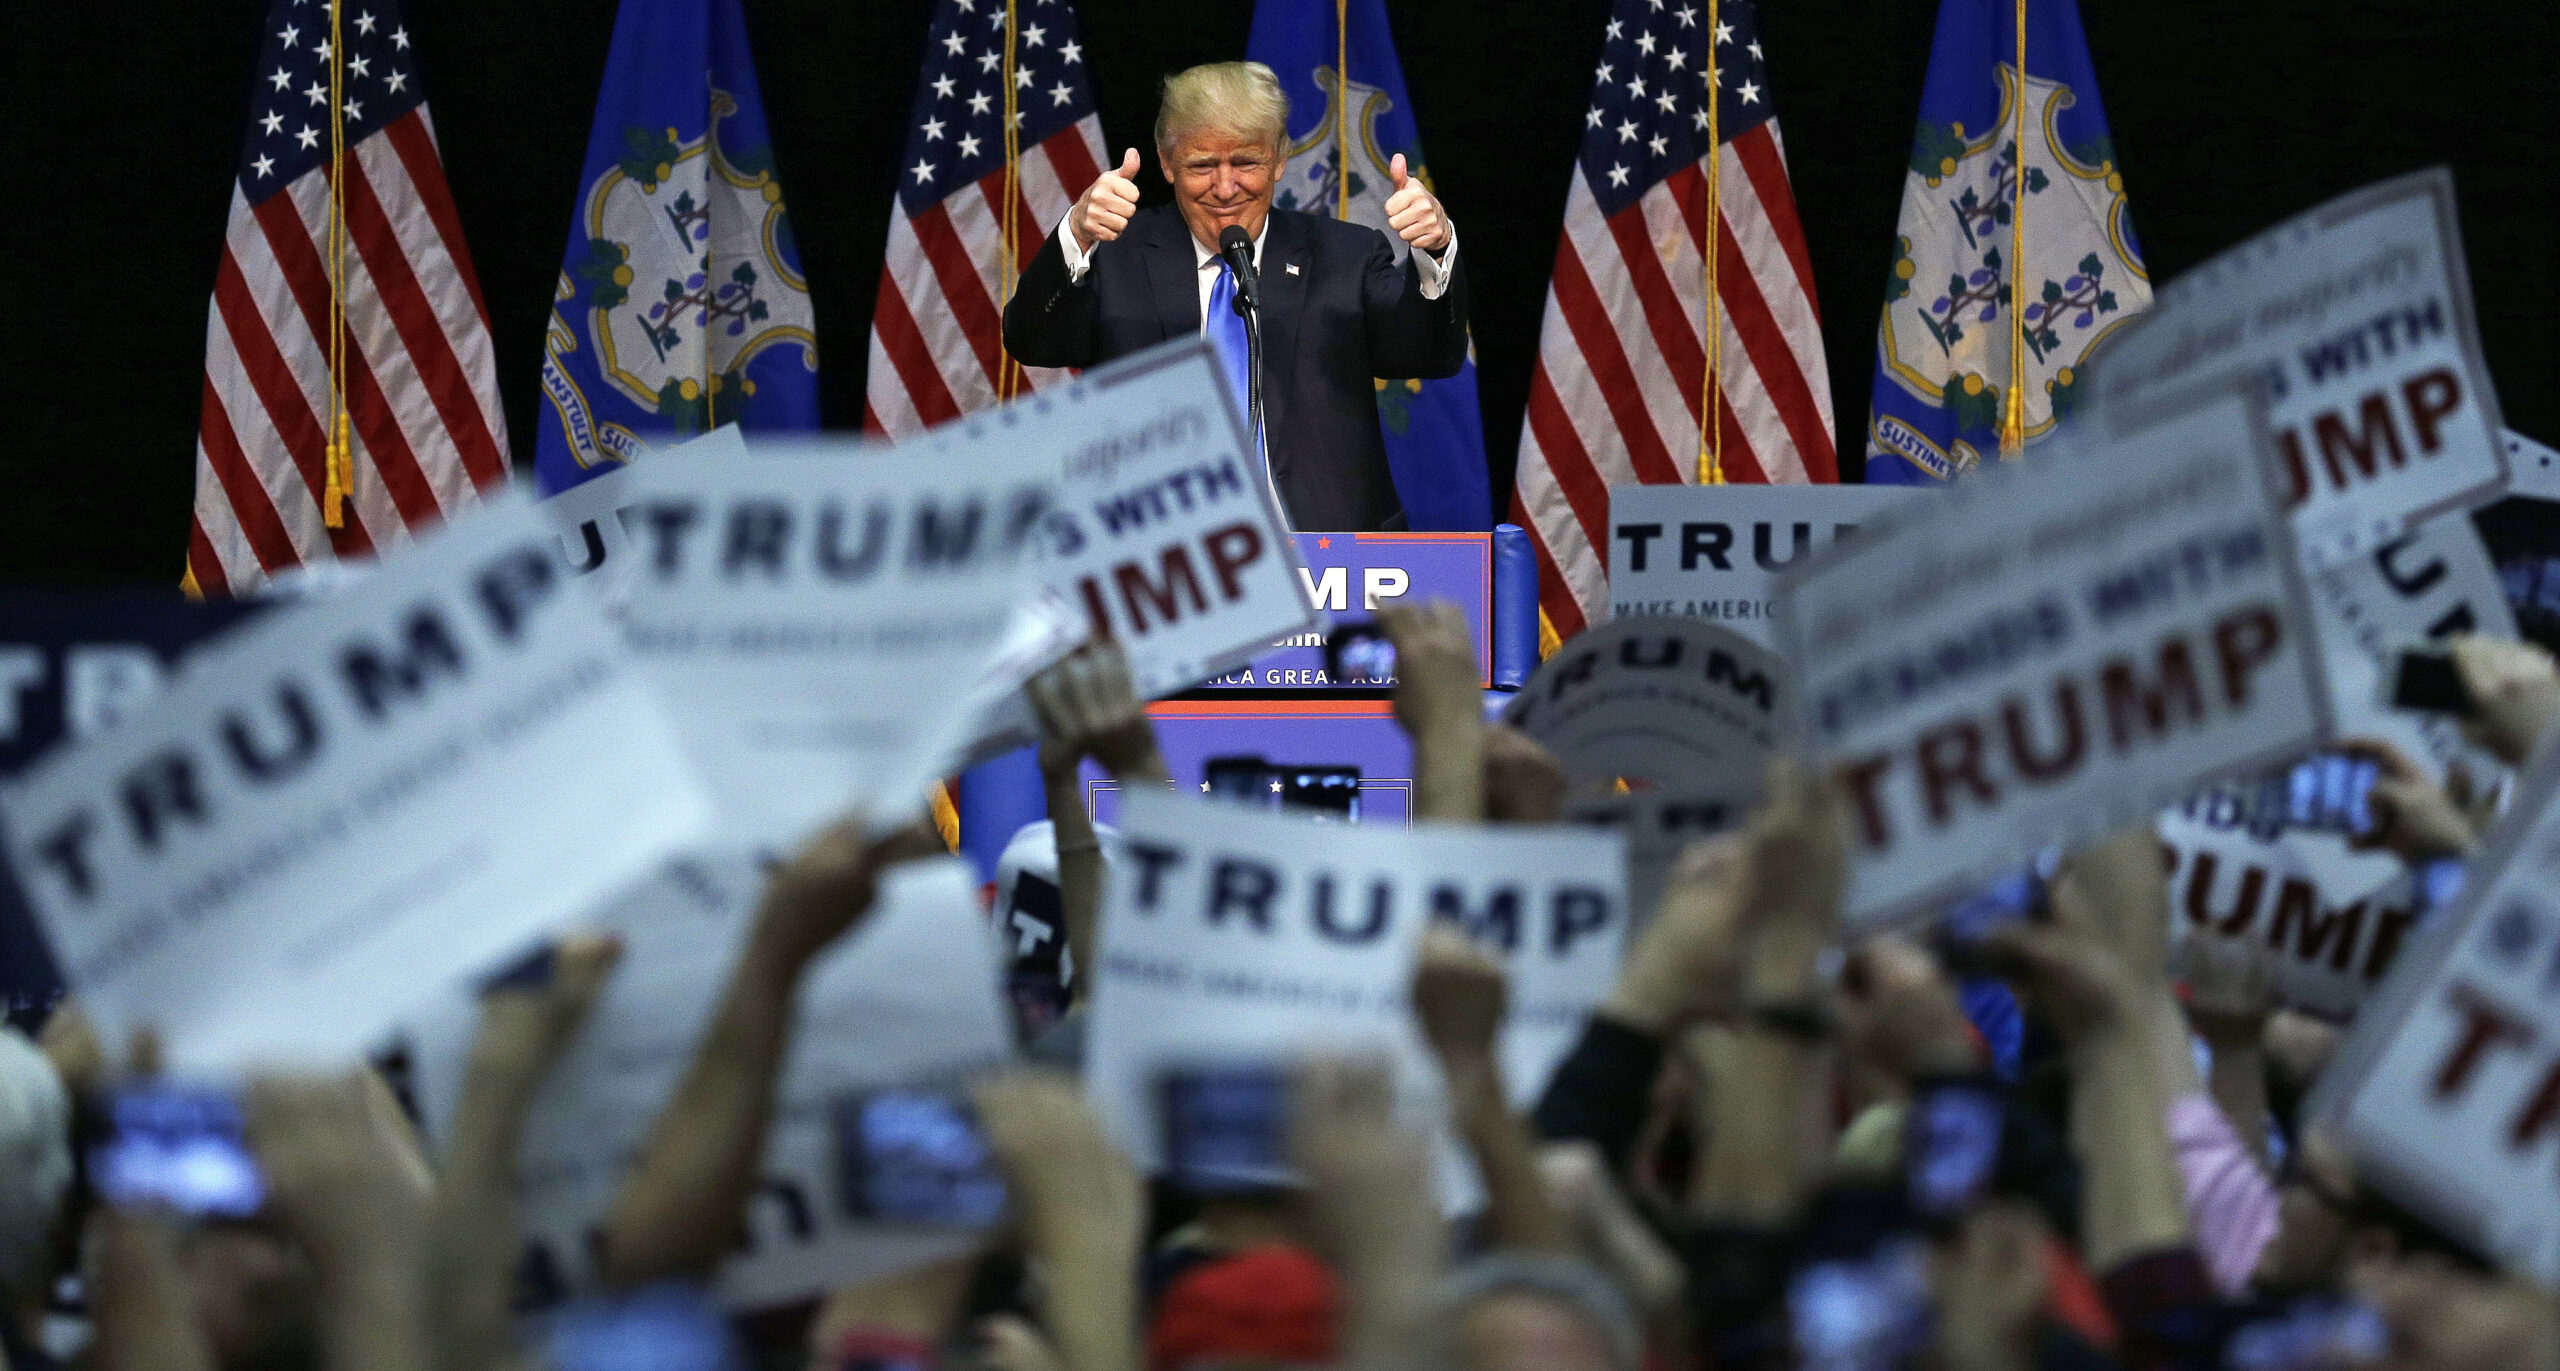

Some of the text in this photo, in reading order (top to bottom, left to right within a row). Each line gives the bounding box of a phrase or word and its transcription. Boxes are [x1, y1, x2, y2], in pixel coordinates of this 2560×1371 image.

[2301, 298, 2443, 383] WITH
[543, 352, 592, 452] ANSTULIT
[1094, 457, 1242, 536] WITH
[1617, 522, 1857, 573] TRU
[1615, 601, 1676, 618] MAKE
[1266, 669, 1338, 685] GREA
[38, 545, 558, 898] TRUMP
[1840, 602, 2284, 851] TRUMP
[1126, 843, 1610, 958] TRUMP
